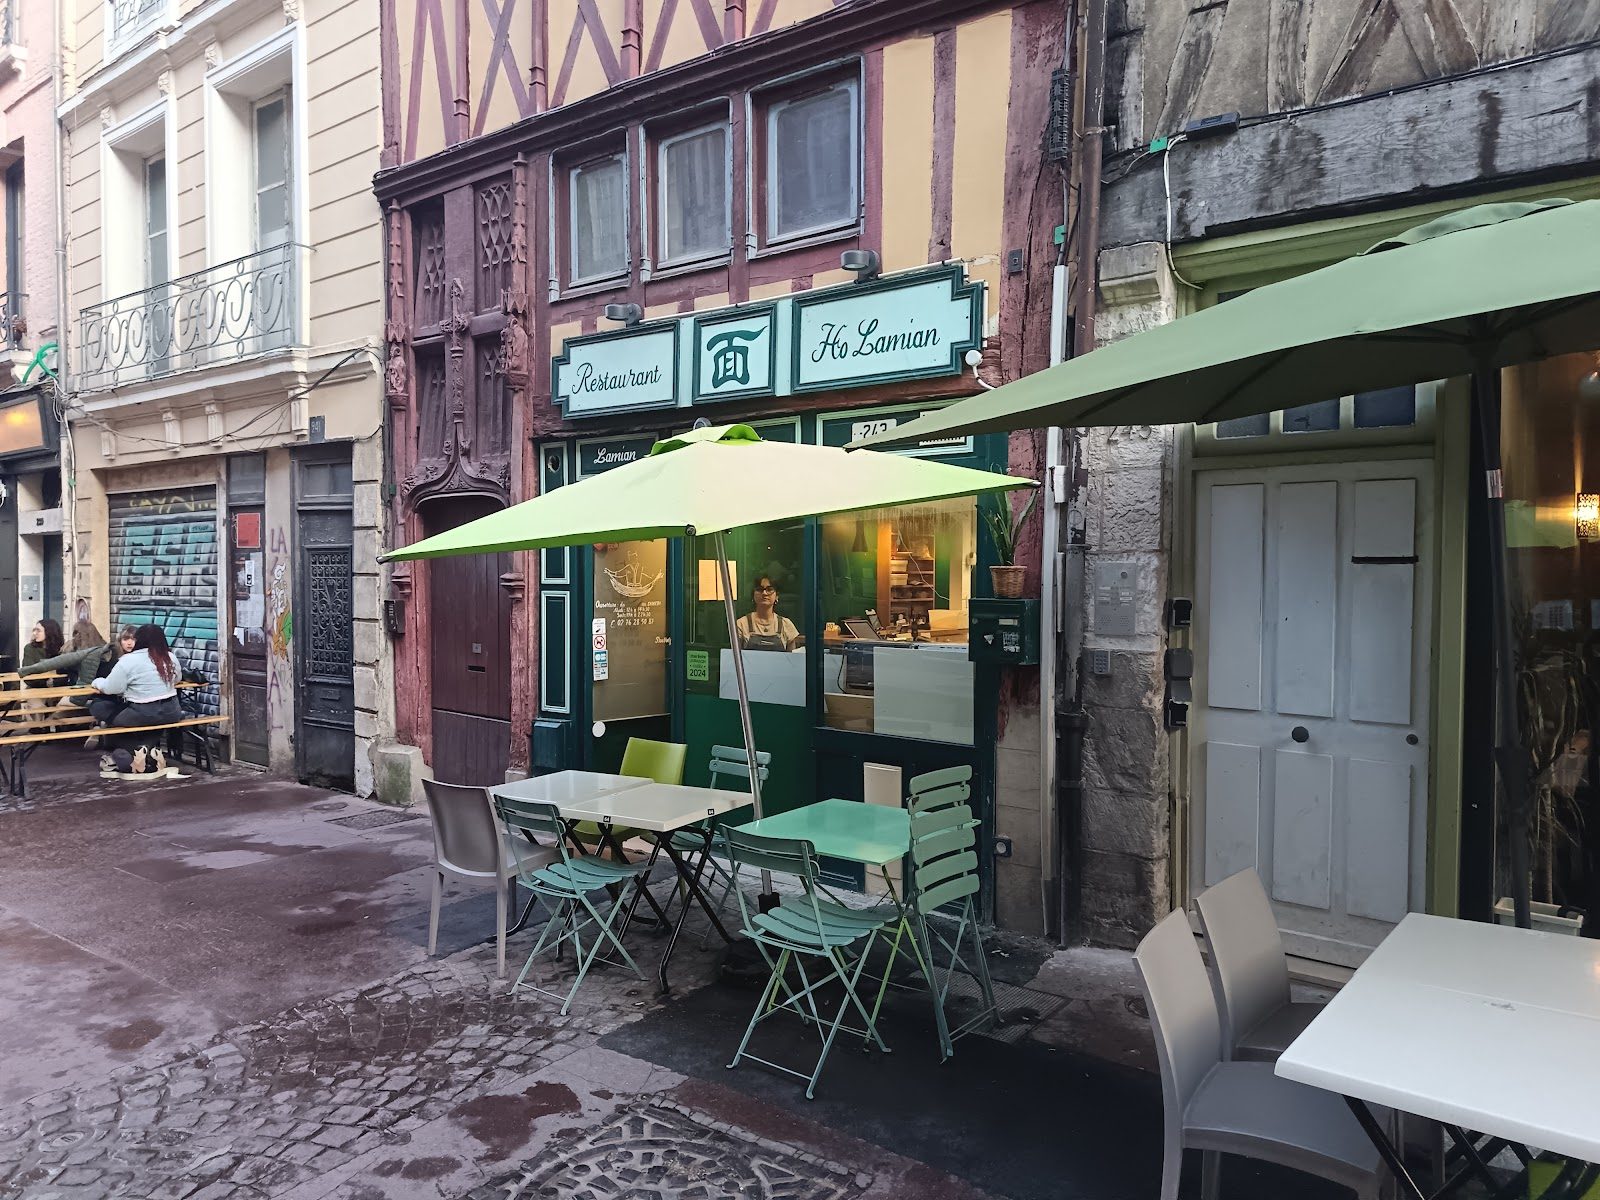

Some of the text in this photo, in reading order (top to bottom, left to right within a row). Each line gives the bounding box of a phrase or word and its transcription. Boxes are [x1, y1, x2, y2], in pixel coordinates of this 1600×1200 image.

[811, 318, 940, 363] Ho Lamian
[572, 362, 662, 395] Restaurant
[593, 445, 637, 464] Lamian
[689, 668, 706, 677] 2024
